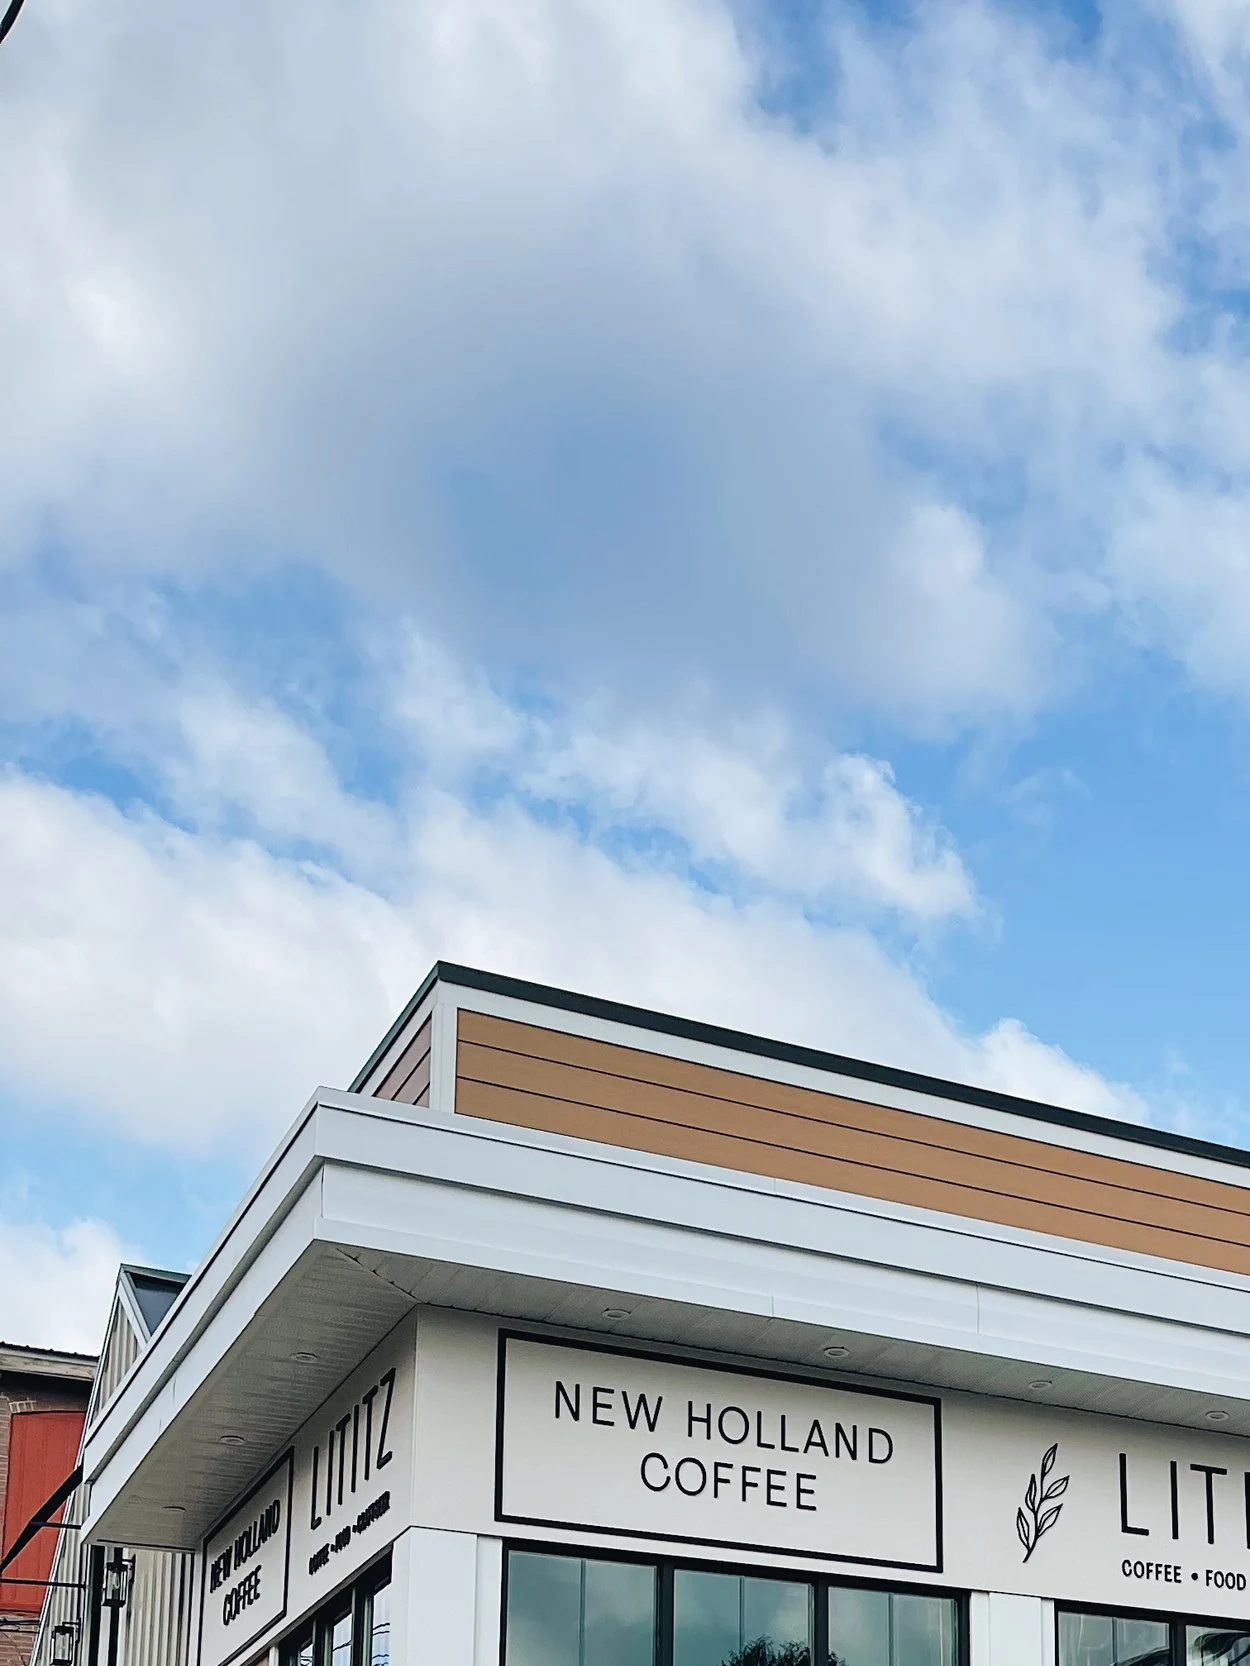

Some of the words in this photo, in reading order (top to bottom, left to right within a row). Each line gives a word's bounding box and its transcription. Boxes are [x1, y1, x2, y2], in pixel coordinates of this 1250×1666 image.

[310, 1367, 397, 1530] LITITZ
[555, 1381, 663, 1433] NEW
[687, 1400, 894, 1464] HOLLAND
[640, 1452, 817, 1511] COFFEE
[209, 1545, 233, 1594] NEW
[233, 1499, 281, 1571] HOLLAND
[1121, 1559, 1182, 1584] COFFEE
[1205, 1569, 1247, 1591] FOOD
[222, 1564, 262, 1626] COFFEE
